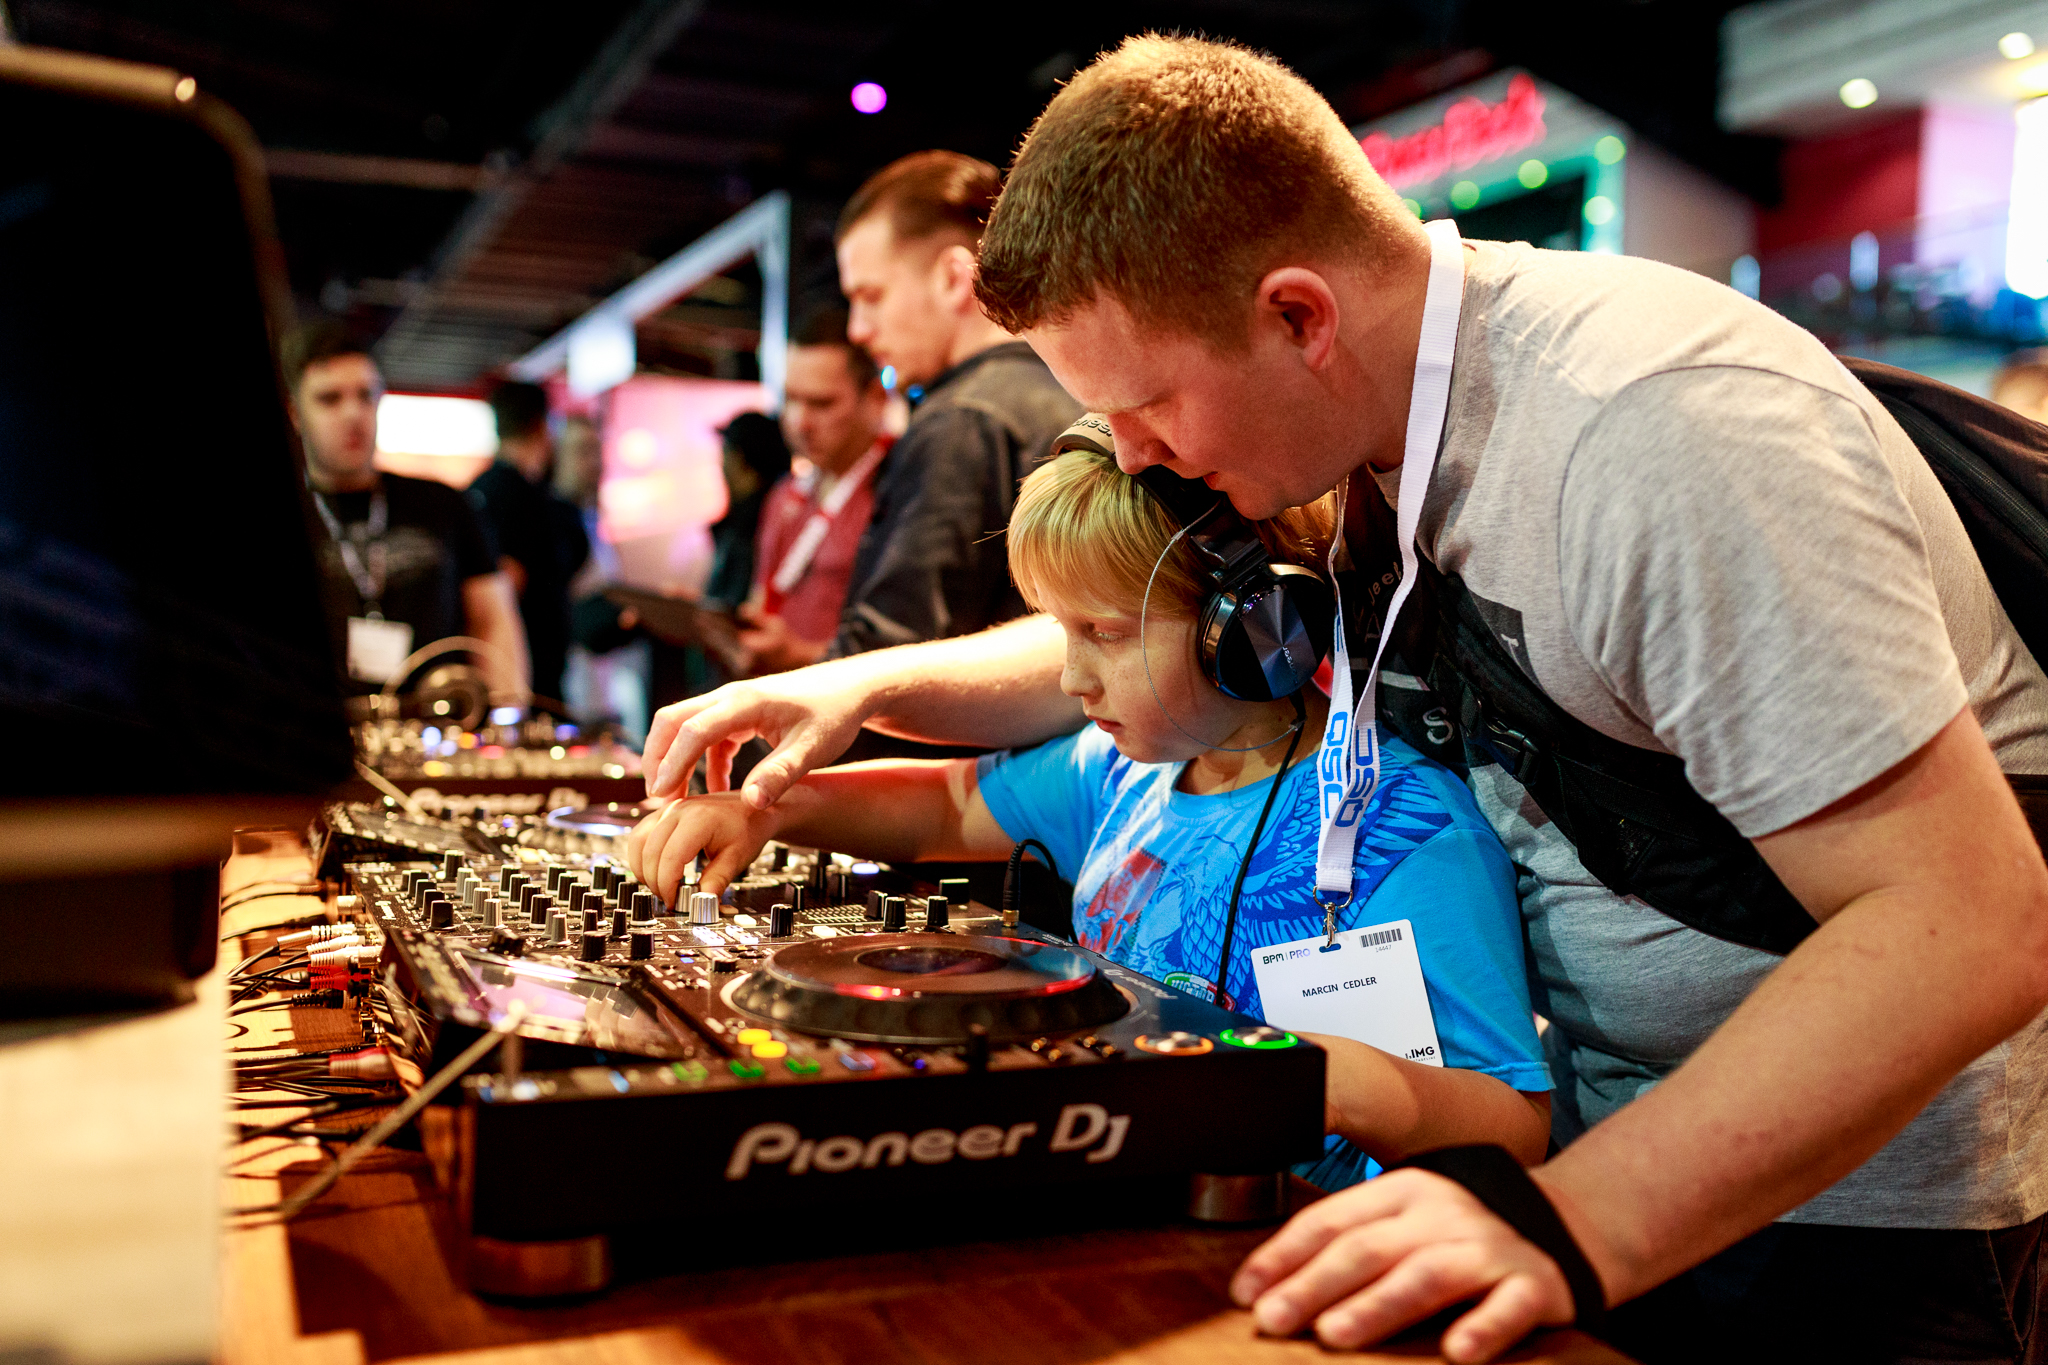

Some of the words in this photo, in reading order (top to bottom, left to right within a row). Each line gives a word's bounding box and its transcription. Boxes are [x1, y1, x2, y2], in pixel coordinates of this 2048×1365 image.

[1283, 646, 1298, 687] oneer
[1322, 711, 1348, 819] QSC
[1335, 728, 1375, 827] QSC
[1263, 953, 1284, 965] BPM
[1290, 948, 1311, 960] PRO
[1302, 983, 1339, 997] MARCIN
[1343, 976, 1377, 990] CEDLER
[724, 1121, 1038, 1181] Pioneer
